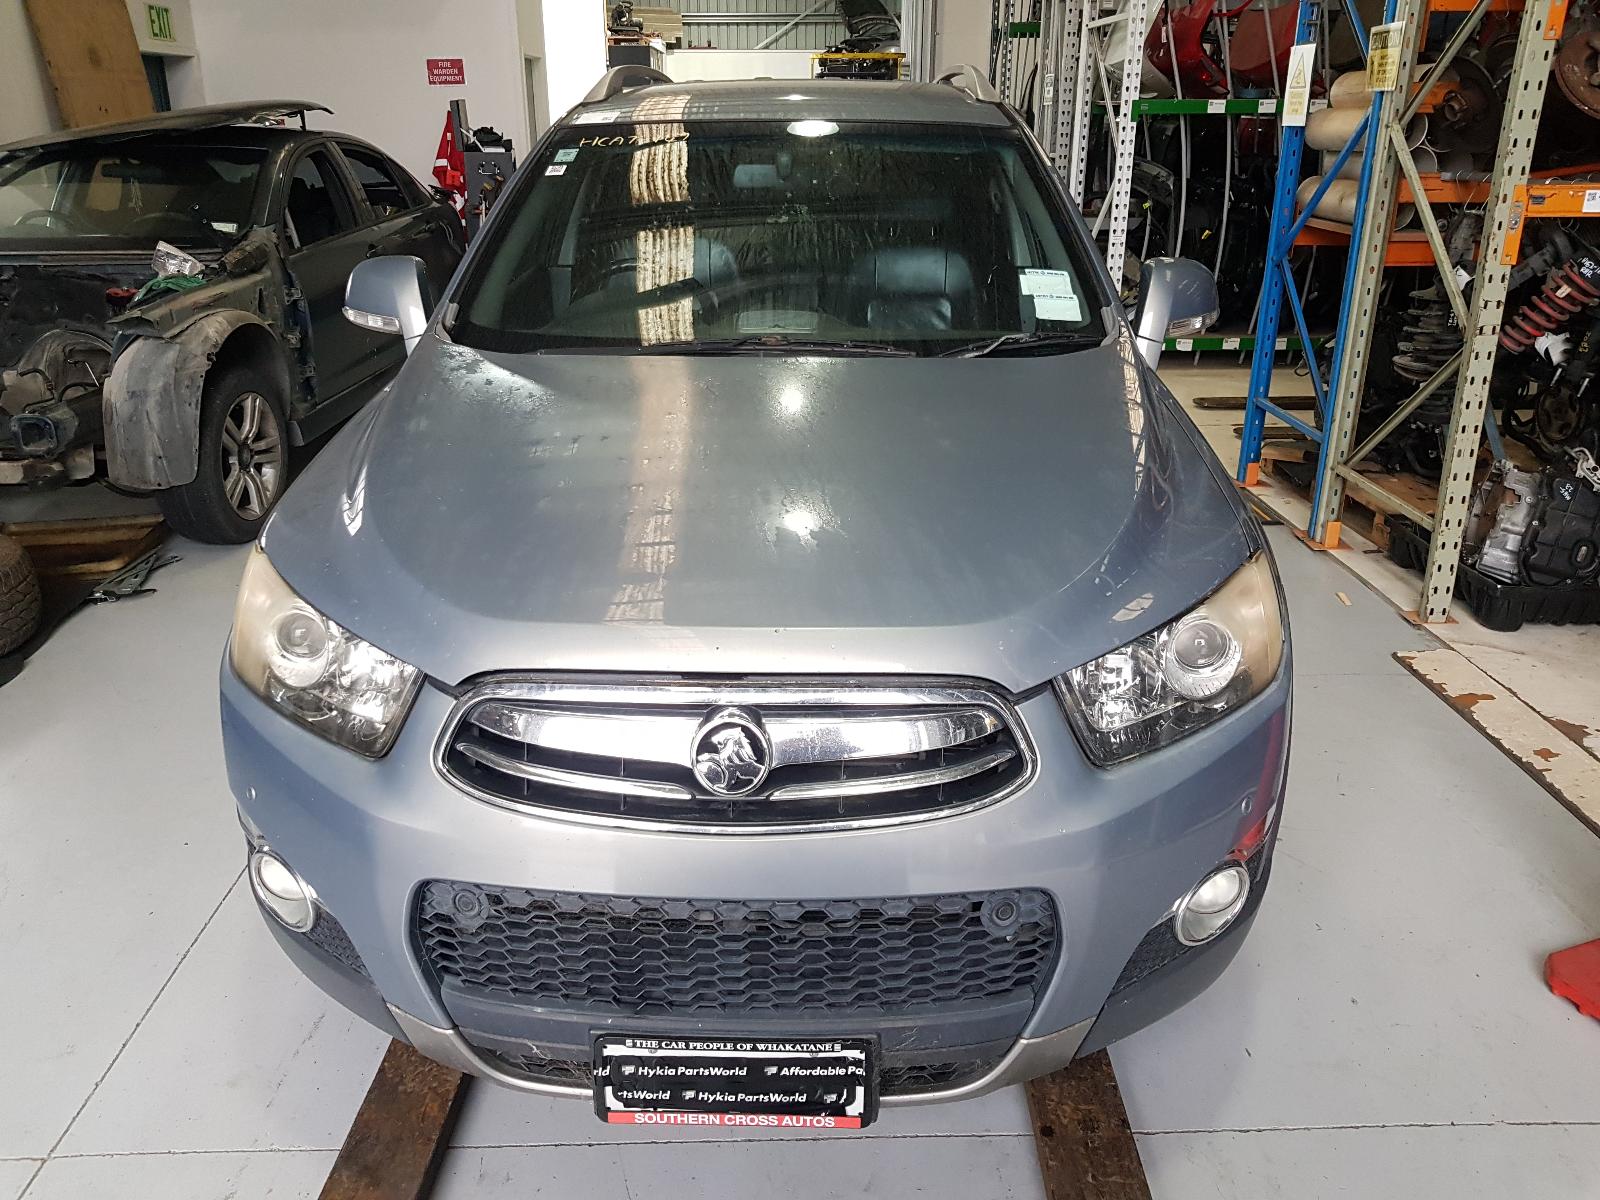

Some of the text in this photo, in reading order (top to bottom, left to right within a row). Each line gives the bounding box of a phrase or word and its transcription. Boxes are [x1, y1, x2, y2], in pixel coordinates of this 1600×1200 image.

[148, 5, 171, 39] EXIT
[635, 1040, 834, 1052] THE CAR PEOPLE OF WHAKATANE
[638, 1066, 677, 1078] Hykia
[677, 1066, 748, 1077] PartsWorld
[780, 1066, 847, 1077] Affordable
[698, 1091, 736, 1103] Hykia
[737, 1092, 807, 1103] PartsWorld
[634, 1112, 836, 1127] SOUTHERN CROSS AUTOS
